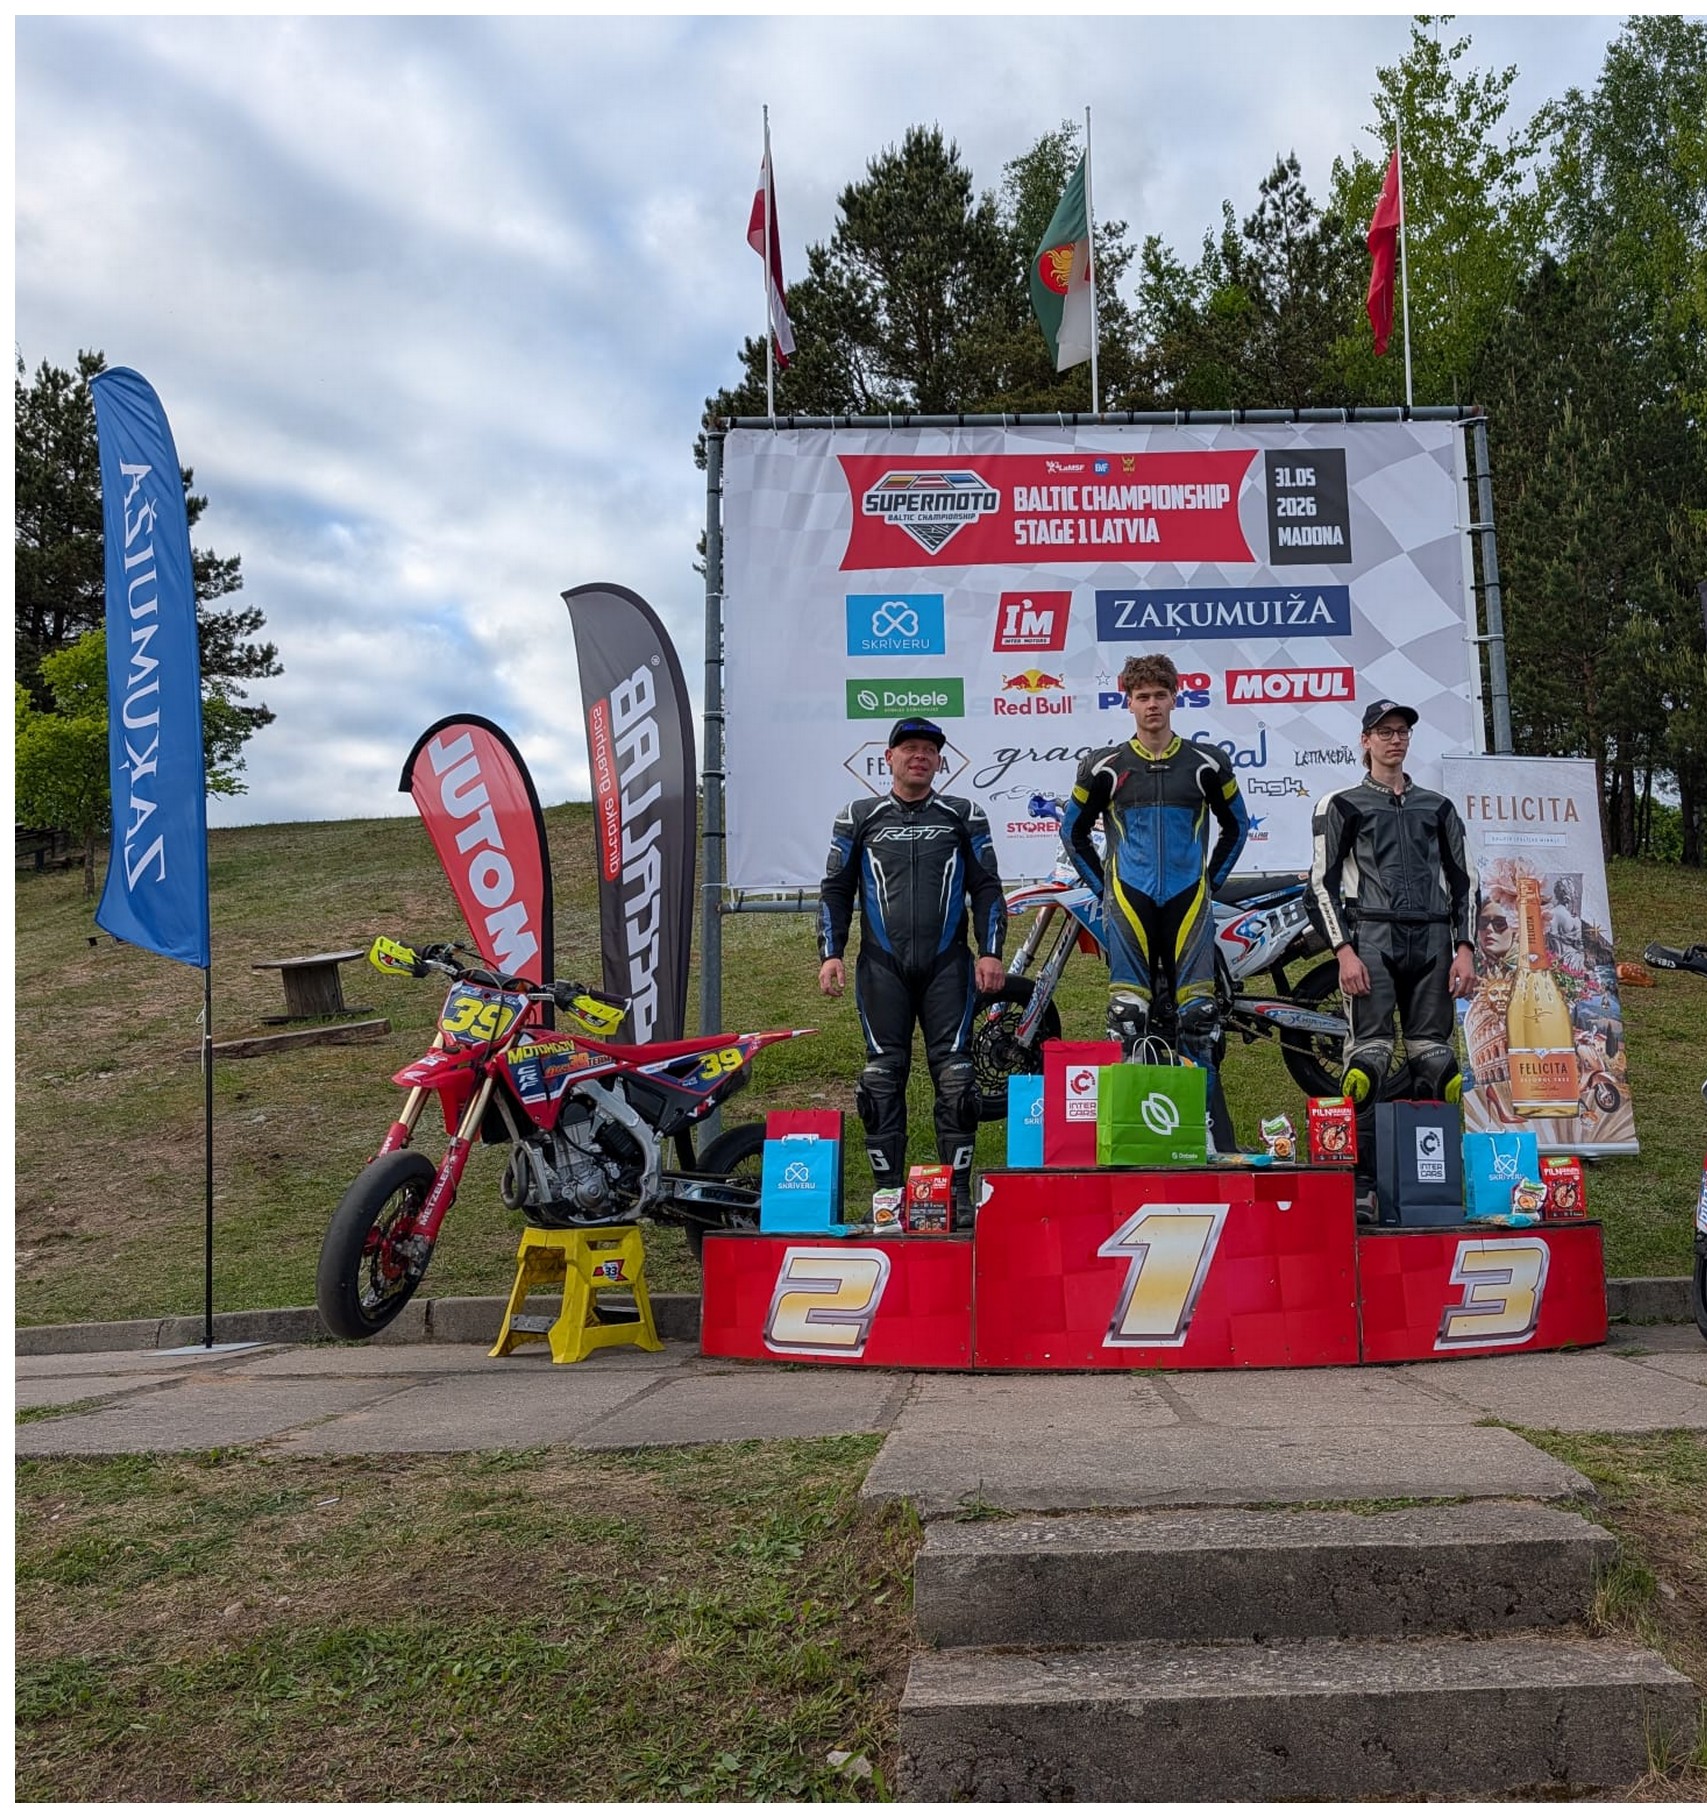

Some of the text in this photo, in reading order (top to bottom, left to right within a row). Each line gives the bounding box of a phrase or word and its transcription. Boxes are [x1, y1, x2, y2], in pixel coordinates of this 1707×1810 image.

[1275, 467, 1316, 487] 31.05
[866, 492, 997, 513] SUPERMOTO
[1014, 484, 1230, 512] BALTIC CHAMPIONSHIP
[1277, 497, 1317, 517] 2026
[888, 512, 976, 522] BALTIC CHAMPIONSHIP
[1015, 518, 1160, 545] STAGE 1 LATVIA
[1278, 526, 1344, 547] MADONA
[1114, 593, 1336, 636] ZAĶUMUIŽA
[1231, 672, 1350, 700] MOTUL
[883, 690, 948, 708] Dobele
[994, 696, 1073, 716] Red Bull
[1466, 795, 1580, 823] FELICITA
[873, 826, 955, 843] RST
[442, 997, 514, 1041] 39
[698, 1048, 744, 1080] 39
[1519, 1061, 1568, 1076] FELICITA
[518, 1065, 538, 1093] CRF
[1068, 1102, 1097, 1110] INTER
[1068, 1109, 1097, 1117] CARS
[1420, 1162, 1443, 1170] INTER
[1420, 1170, 1444, 1178] CARS
[603, 1264, 620, 1278] 33
[1096, 1203, 1230, 1348] 1
[762, 1246, 891, 1358] 2
[1433, 1236, 1551, 1350] 3
